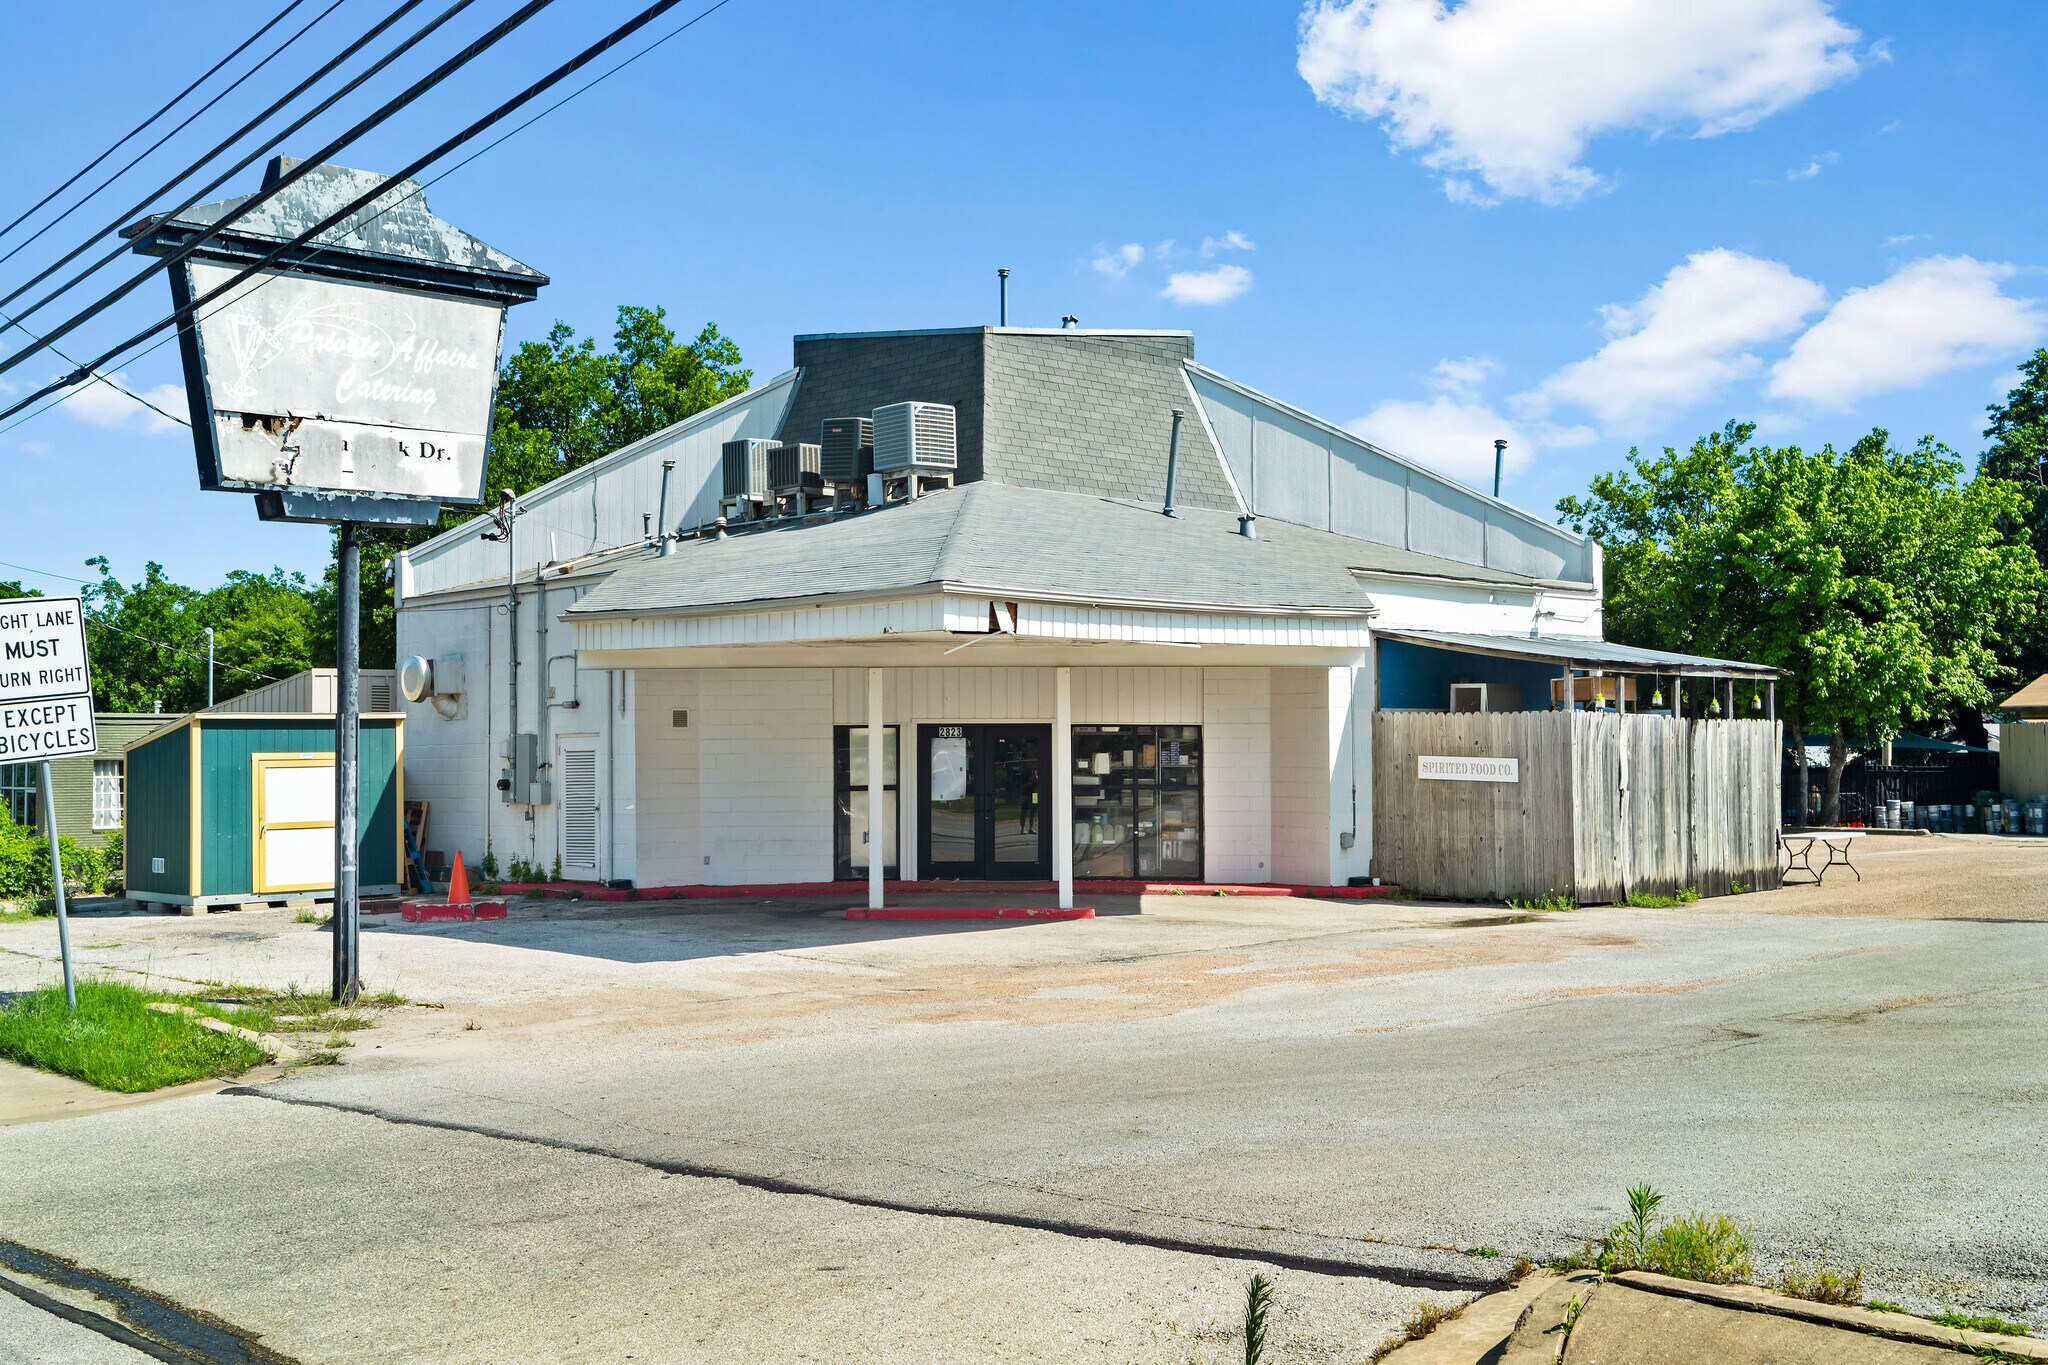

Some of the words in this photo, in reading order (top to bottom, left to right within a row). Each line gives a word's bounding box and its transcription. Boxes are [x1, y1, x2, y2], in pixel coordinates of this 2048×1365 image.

[393, 334, 479, 373] Affairs
[336, 363, 438, 414] Catering
[419, 441, 451, 461] Dr.
[37, 611, 74, 627] LANE
[5, 639, 60, 660] MUST
[39, 667, 83, 684] RIGHT
[4, 704, 77, 728] EXCEPT
[0, 727, 91, 754] BICYCLES
[939, 727, 962, 737] 2823
[1422, 762, 1468, 775] SPIRITED
[1469, 763, 1496, 776] FOOD
[1498, 764, 1513, 777] CO.
